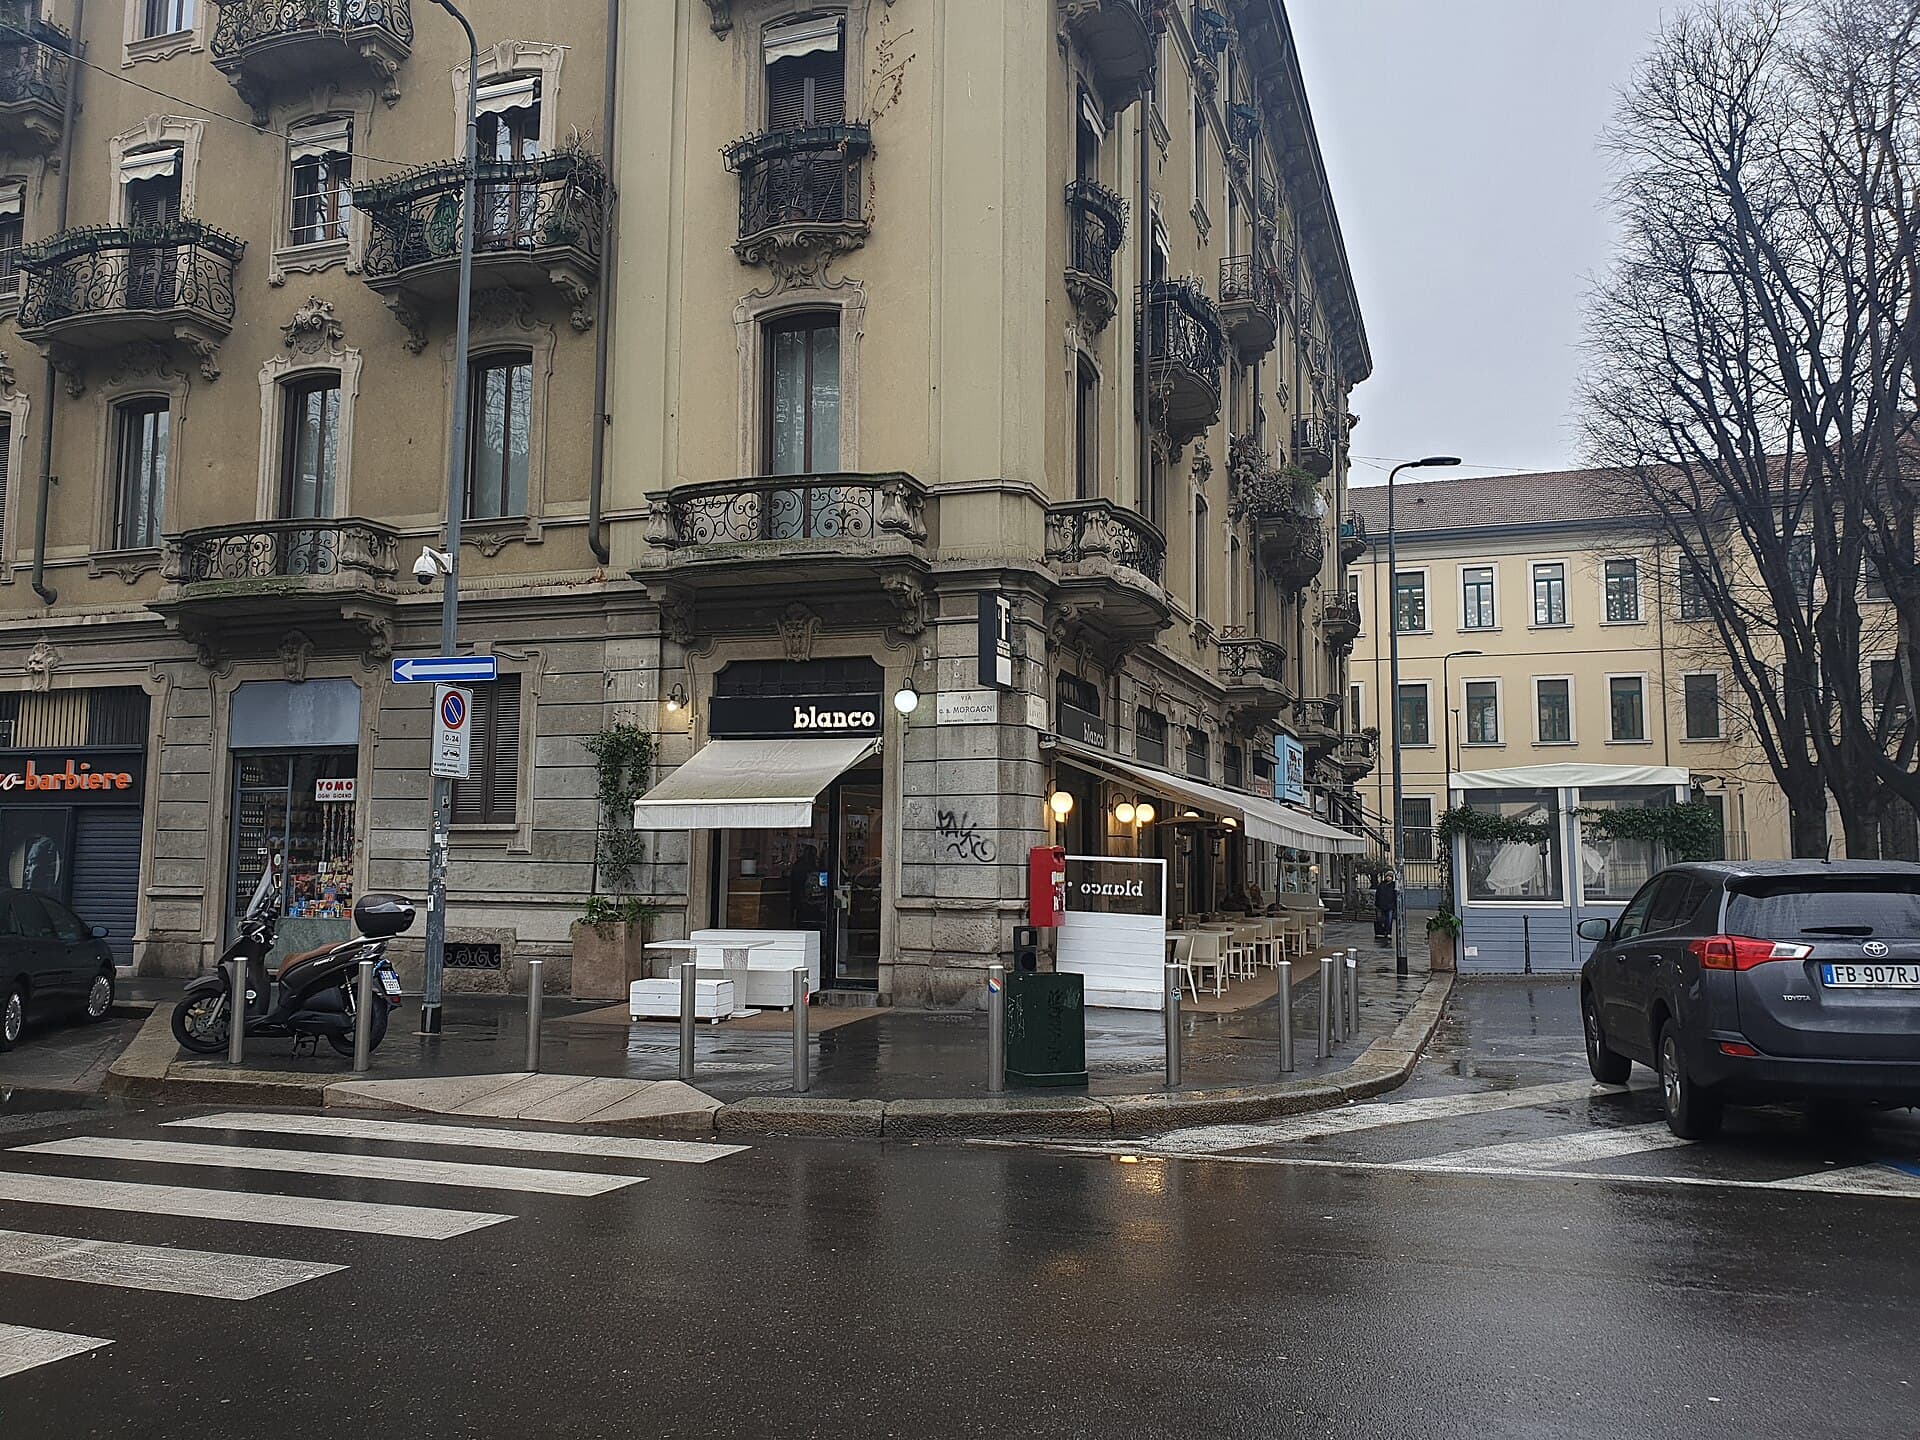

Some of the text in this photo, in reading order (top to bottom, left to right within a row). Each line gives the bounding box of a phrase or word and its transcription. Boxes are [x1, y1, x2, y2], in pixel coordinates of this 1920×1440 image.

[793, 706, 876, 729] blanco
[953, 705, 995, 714] MORGAGNI
[1083, 721, 1104, 748] blanco
[317, 781, 353, 791] YOMO
